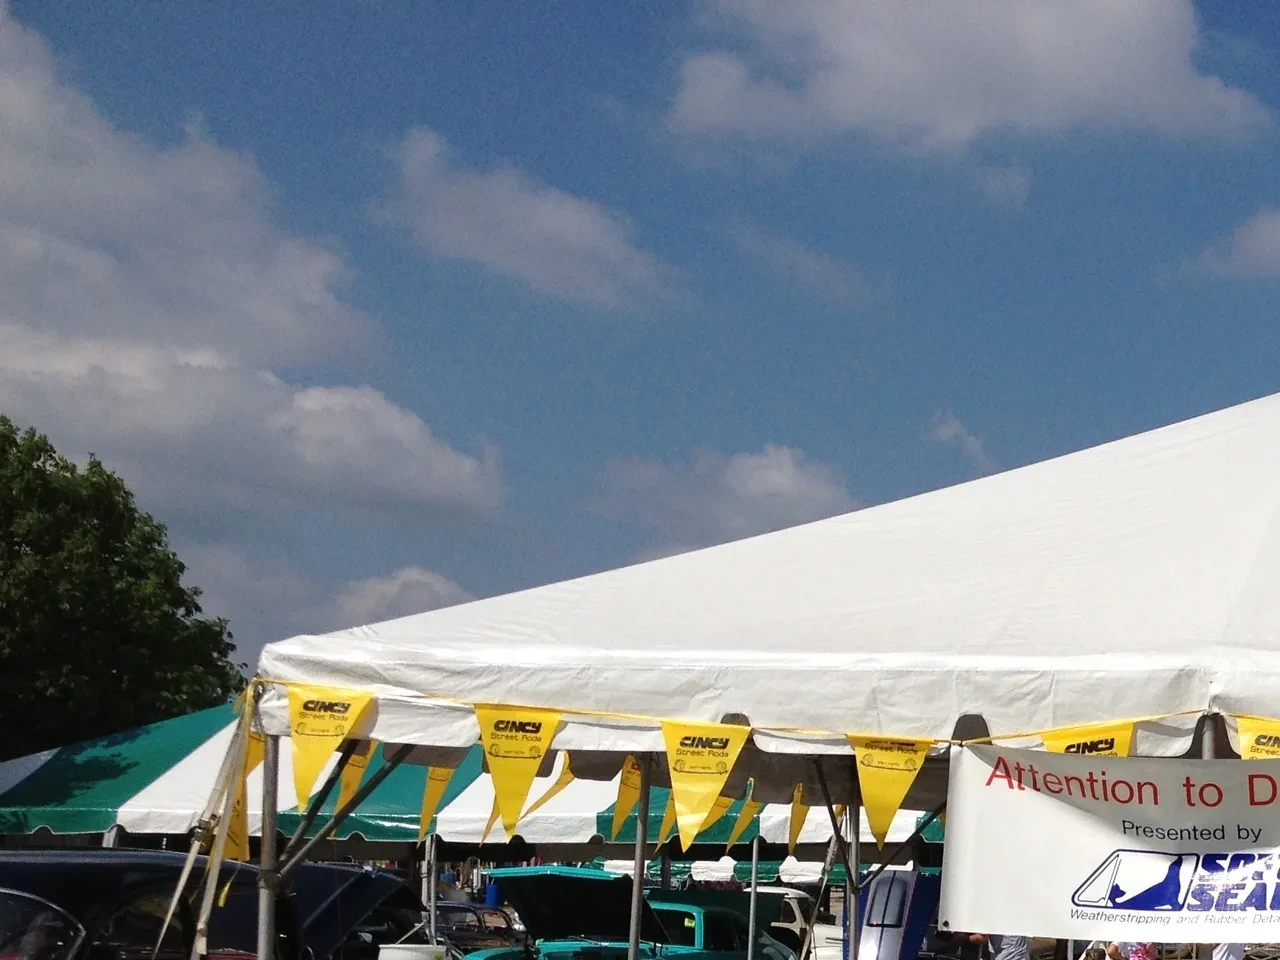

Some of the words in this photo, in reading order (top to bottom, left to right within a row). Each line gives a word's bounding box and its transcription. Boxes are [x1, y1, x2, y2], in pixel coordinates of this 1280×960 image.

[303, 700, 351, 713] CINCY
[494, 720, 542, 733] CINCY
[680, 736, 730, 749] CINCY
[1065, 738, 1115, 754] CINCY
[985, 756, 1159, 806] Attention
[1182, 776, 1224, 807] to
[1122, 820, 1226, 841] Presented
[1237, 824, 1263, 843] by
[1070, 909, 1171, 926] Weatherstripping
[1176, 914, 1199, 924] and
[1204, 914, 1248, 924] Rubber
